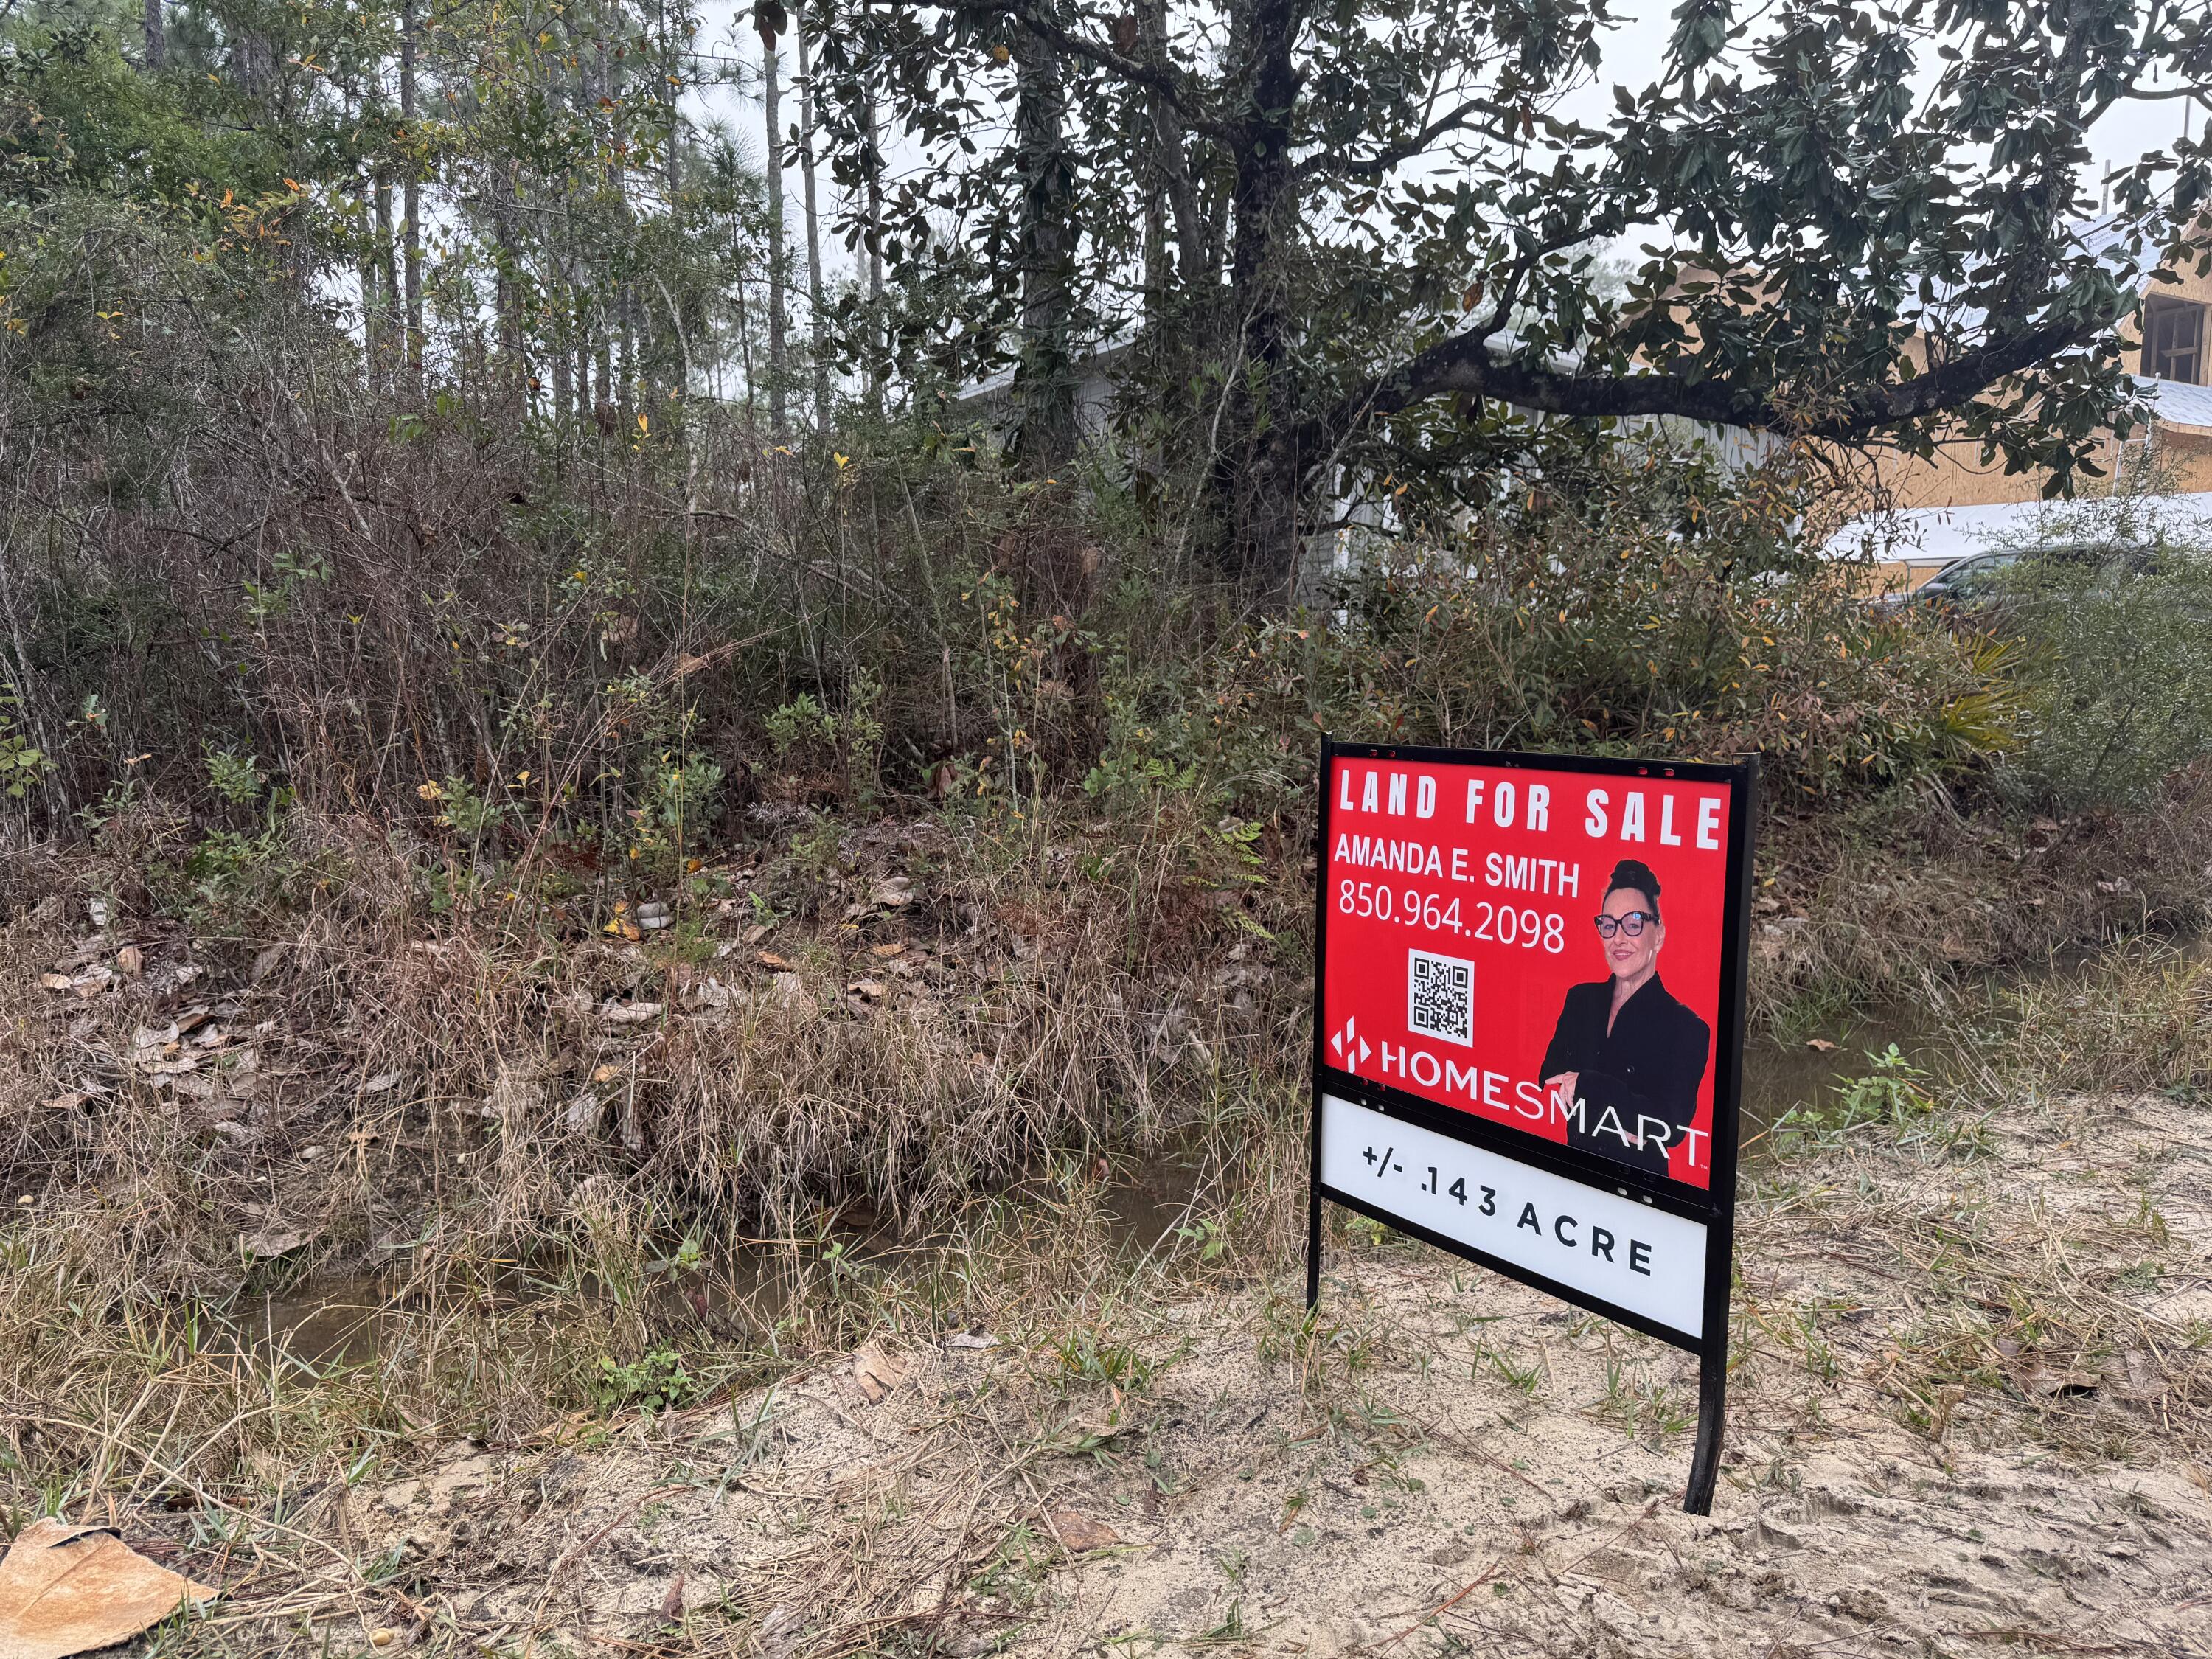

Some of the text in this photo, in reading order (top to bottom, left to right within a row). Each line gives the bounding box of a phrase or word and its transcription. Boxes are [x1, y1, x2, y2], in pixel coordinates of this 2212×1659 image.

[1340, 769, 1722, 850] LAND FOR SALE
[1334, 833, 1580, 899] AMANDA E. SMITH
[1338, 878, 1565, 954] 850.964.2098
[1380, 1040, 1710, 1167] HOMESMART
[1363, 1146, 1652, 1277] +/- .143 ACRE
